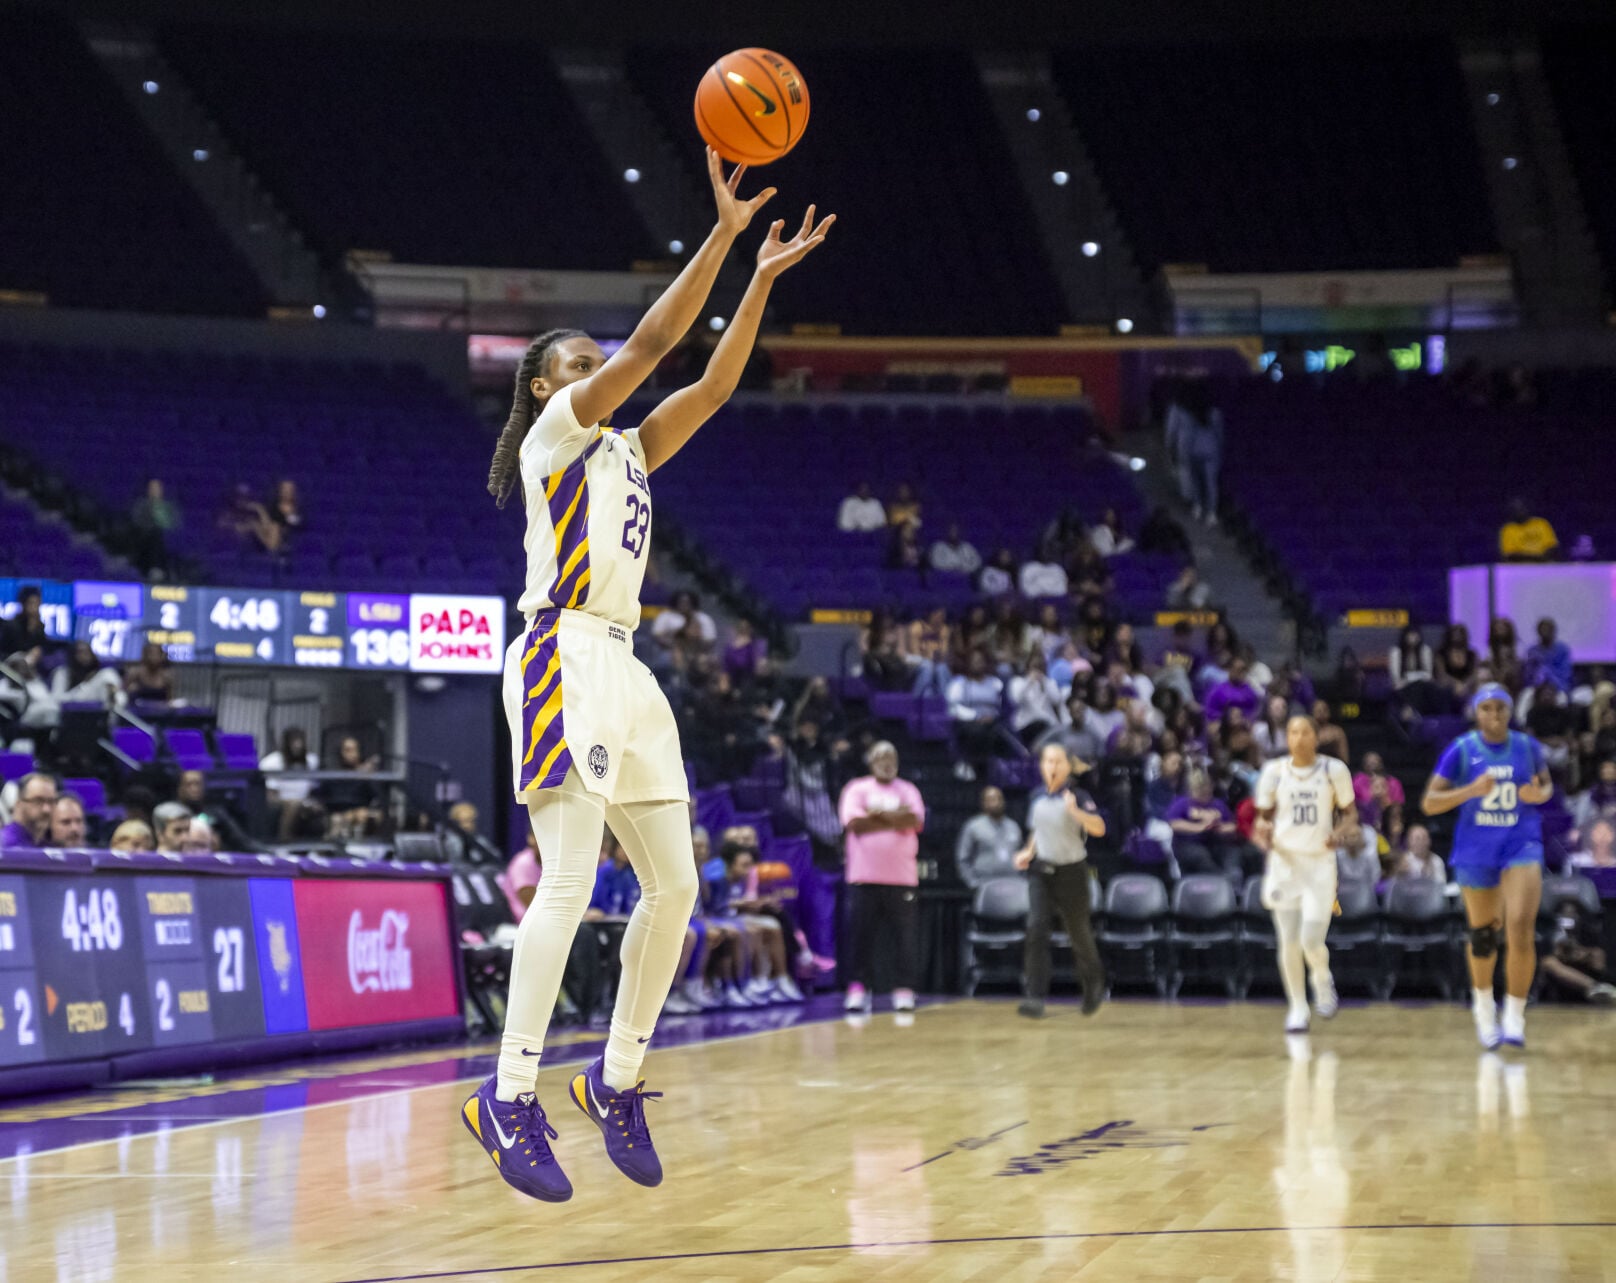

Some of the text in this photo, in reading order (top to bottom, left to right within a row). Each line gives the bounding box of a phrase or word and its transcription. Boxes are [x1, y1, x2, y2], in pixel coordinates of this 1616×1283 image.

[621, 493, 650, 560] 23
[160, 602, 179, 629] 2
[210, 596, 280, 632] 4:48
[309, 608, 328, 634] 2
[420, 609, 491, 636] PAPA
[256, 637, 273, 660] 4
[351, 628, 410, 666] 136
[1481, 781, 1517, 811] 20
[62, 887, 123, 952] 4:48
[214, 926, 244, 992] 27
[14, 987, 35, 1046] 2
[119, 992, 135, 1036] 4
[156, 977, 175, 1031] 2
